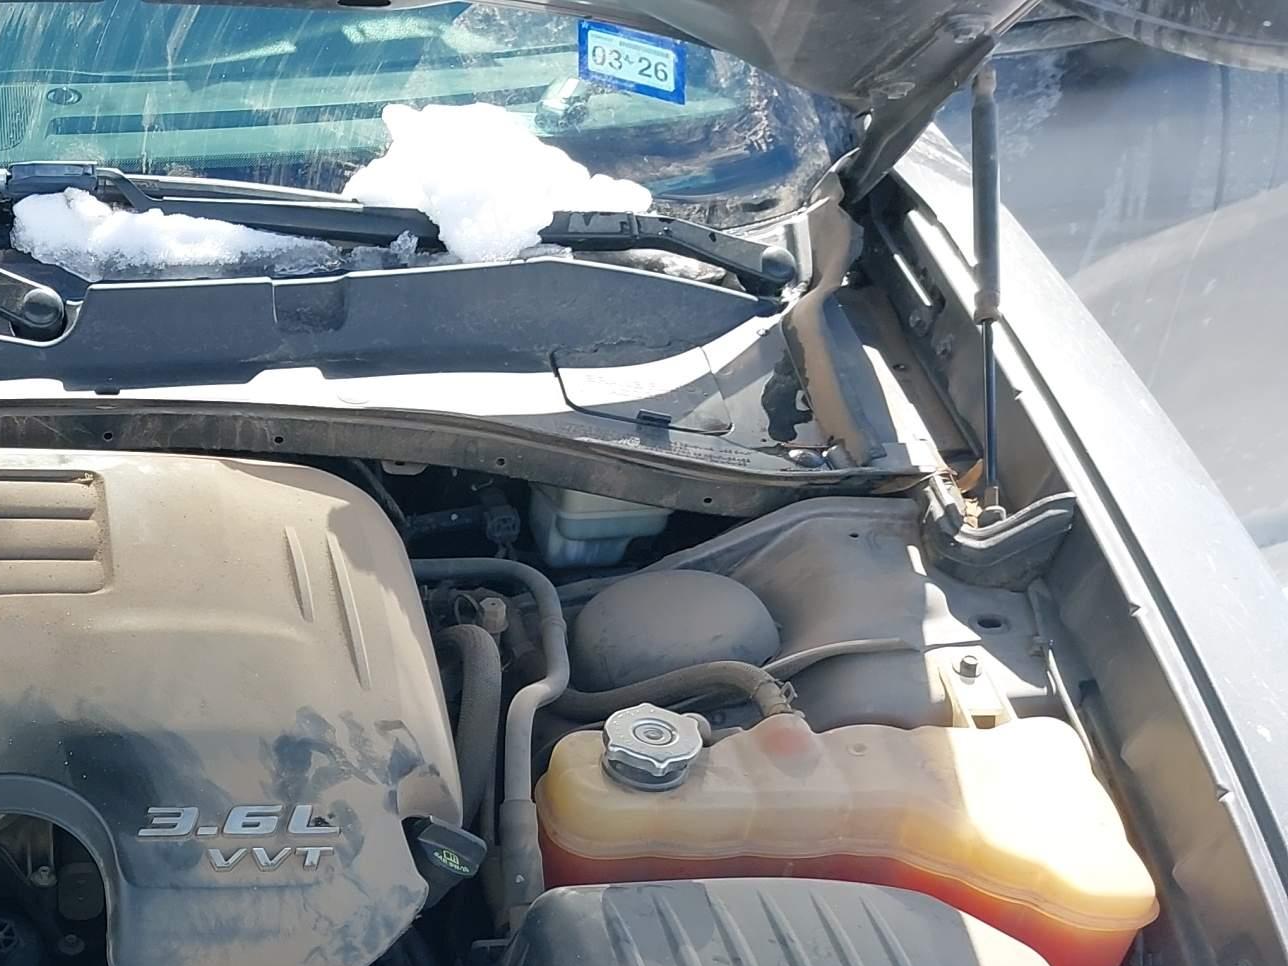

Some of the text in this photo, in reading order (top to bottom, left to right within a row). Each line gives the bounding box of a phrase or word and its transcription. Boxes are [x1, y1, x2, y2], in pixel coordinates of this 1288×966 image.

[592, 44, 623, 71] 03
[638, 56, 669, 82] 26
[137, 804, 341, 837] 3.6L
[207, 846, 335, 872] VVT
